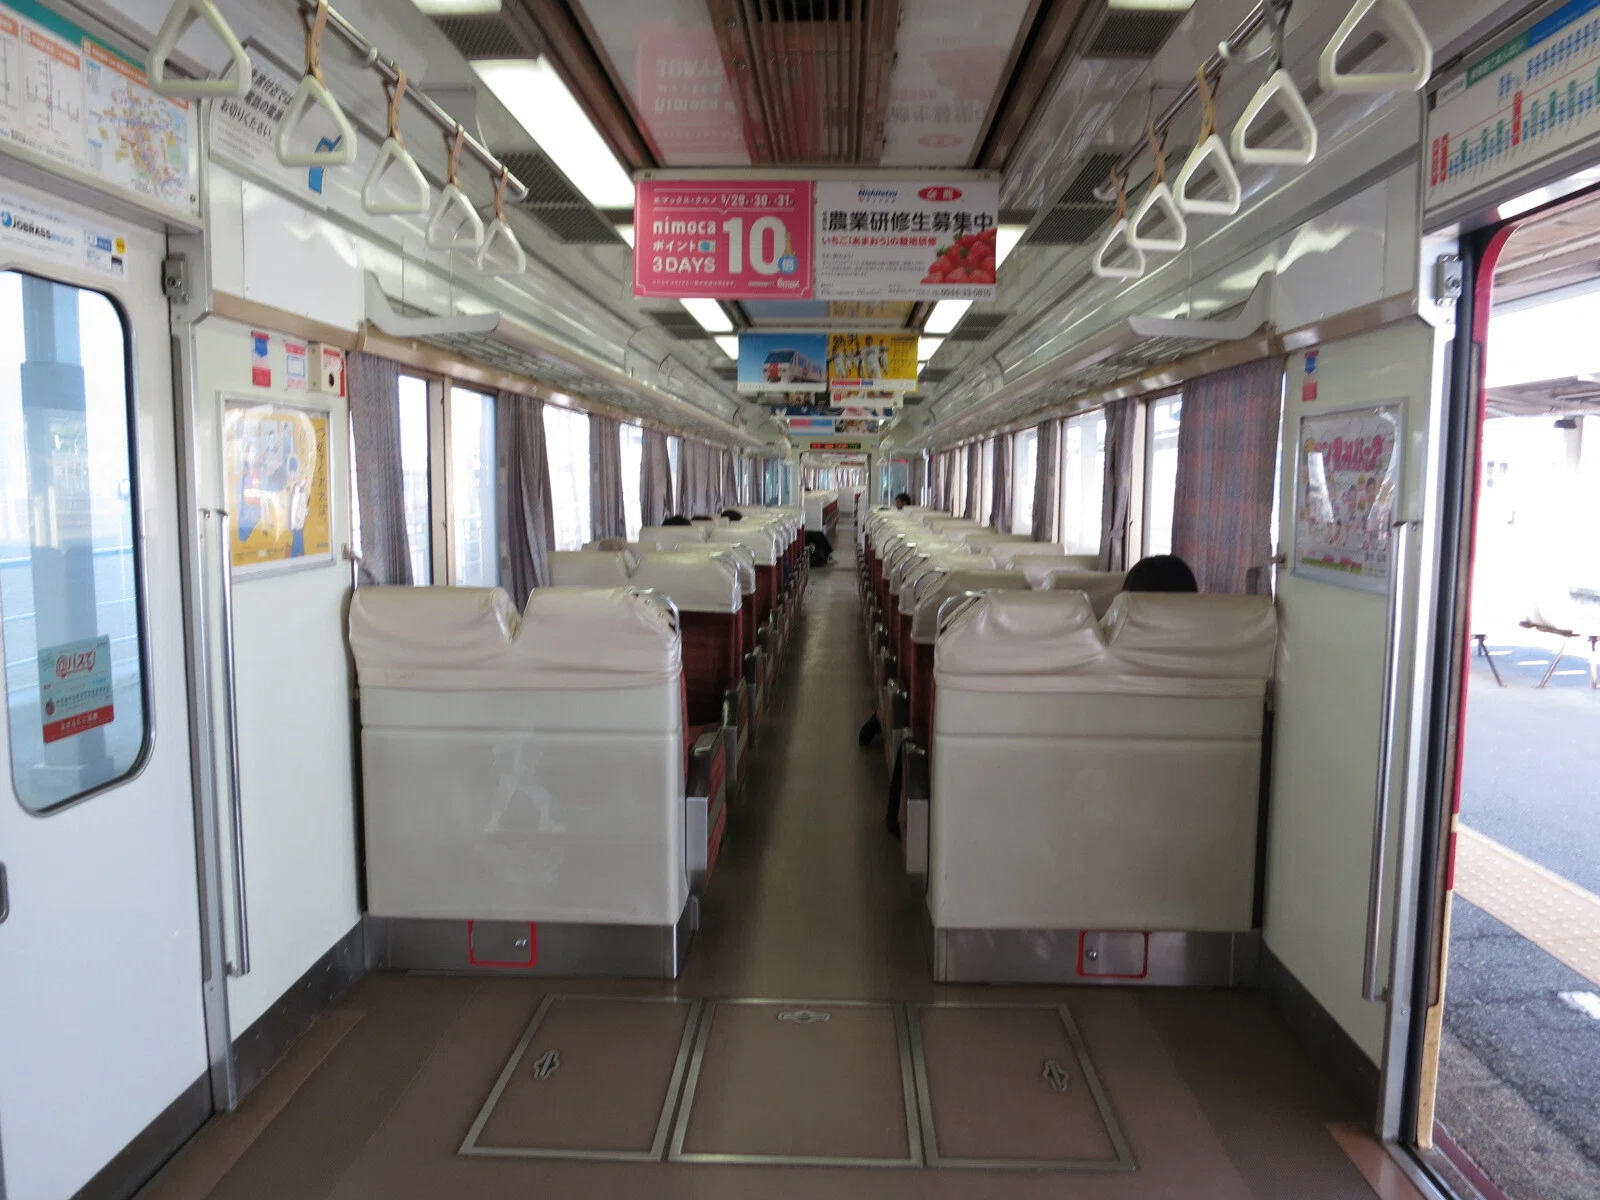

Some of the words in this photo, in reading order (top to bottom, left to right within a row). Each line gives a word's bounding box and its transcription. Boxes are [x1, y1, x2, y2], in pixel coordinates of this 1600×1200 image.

[653, 216, 717, 236] nimoca
[828, 210, 994, 233] 農業研修生募集中
[653, 239, 697, 254] ポイント
[722, 215, 788, 276] 10
